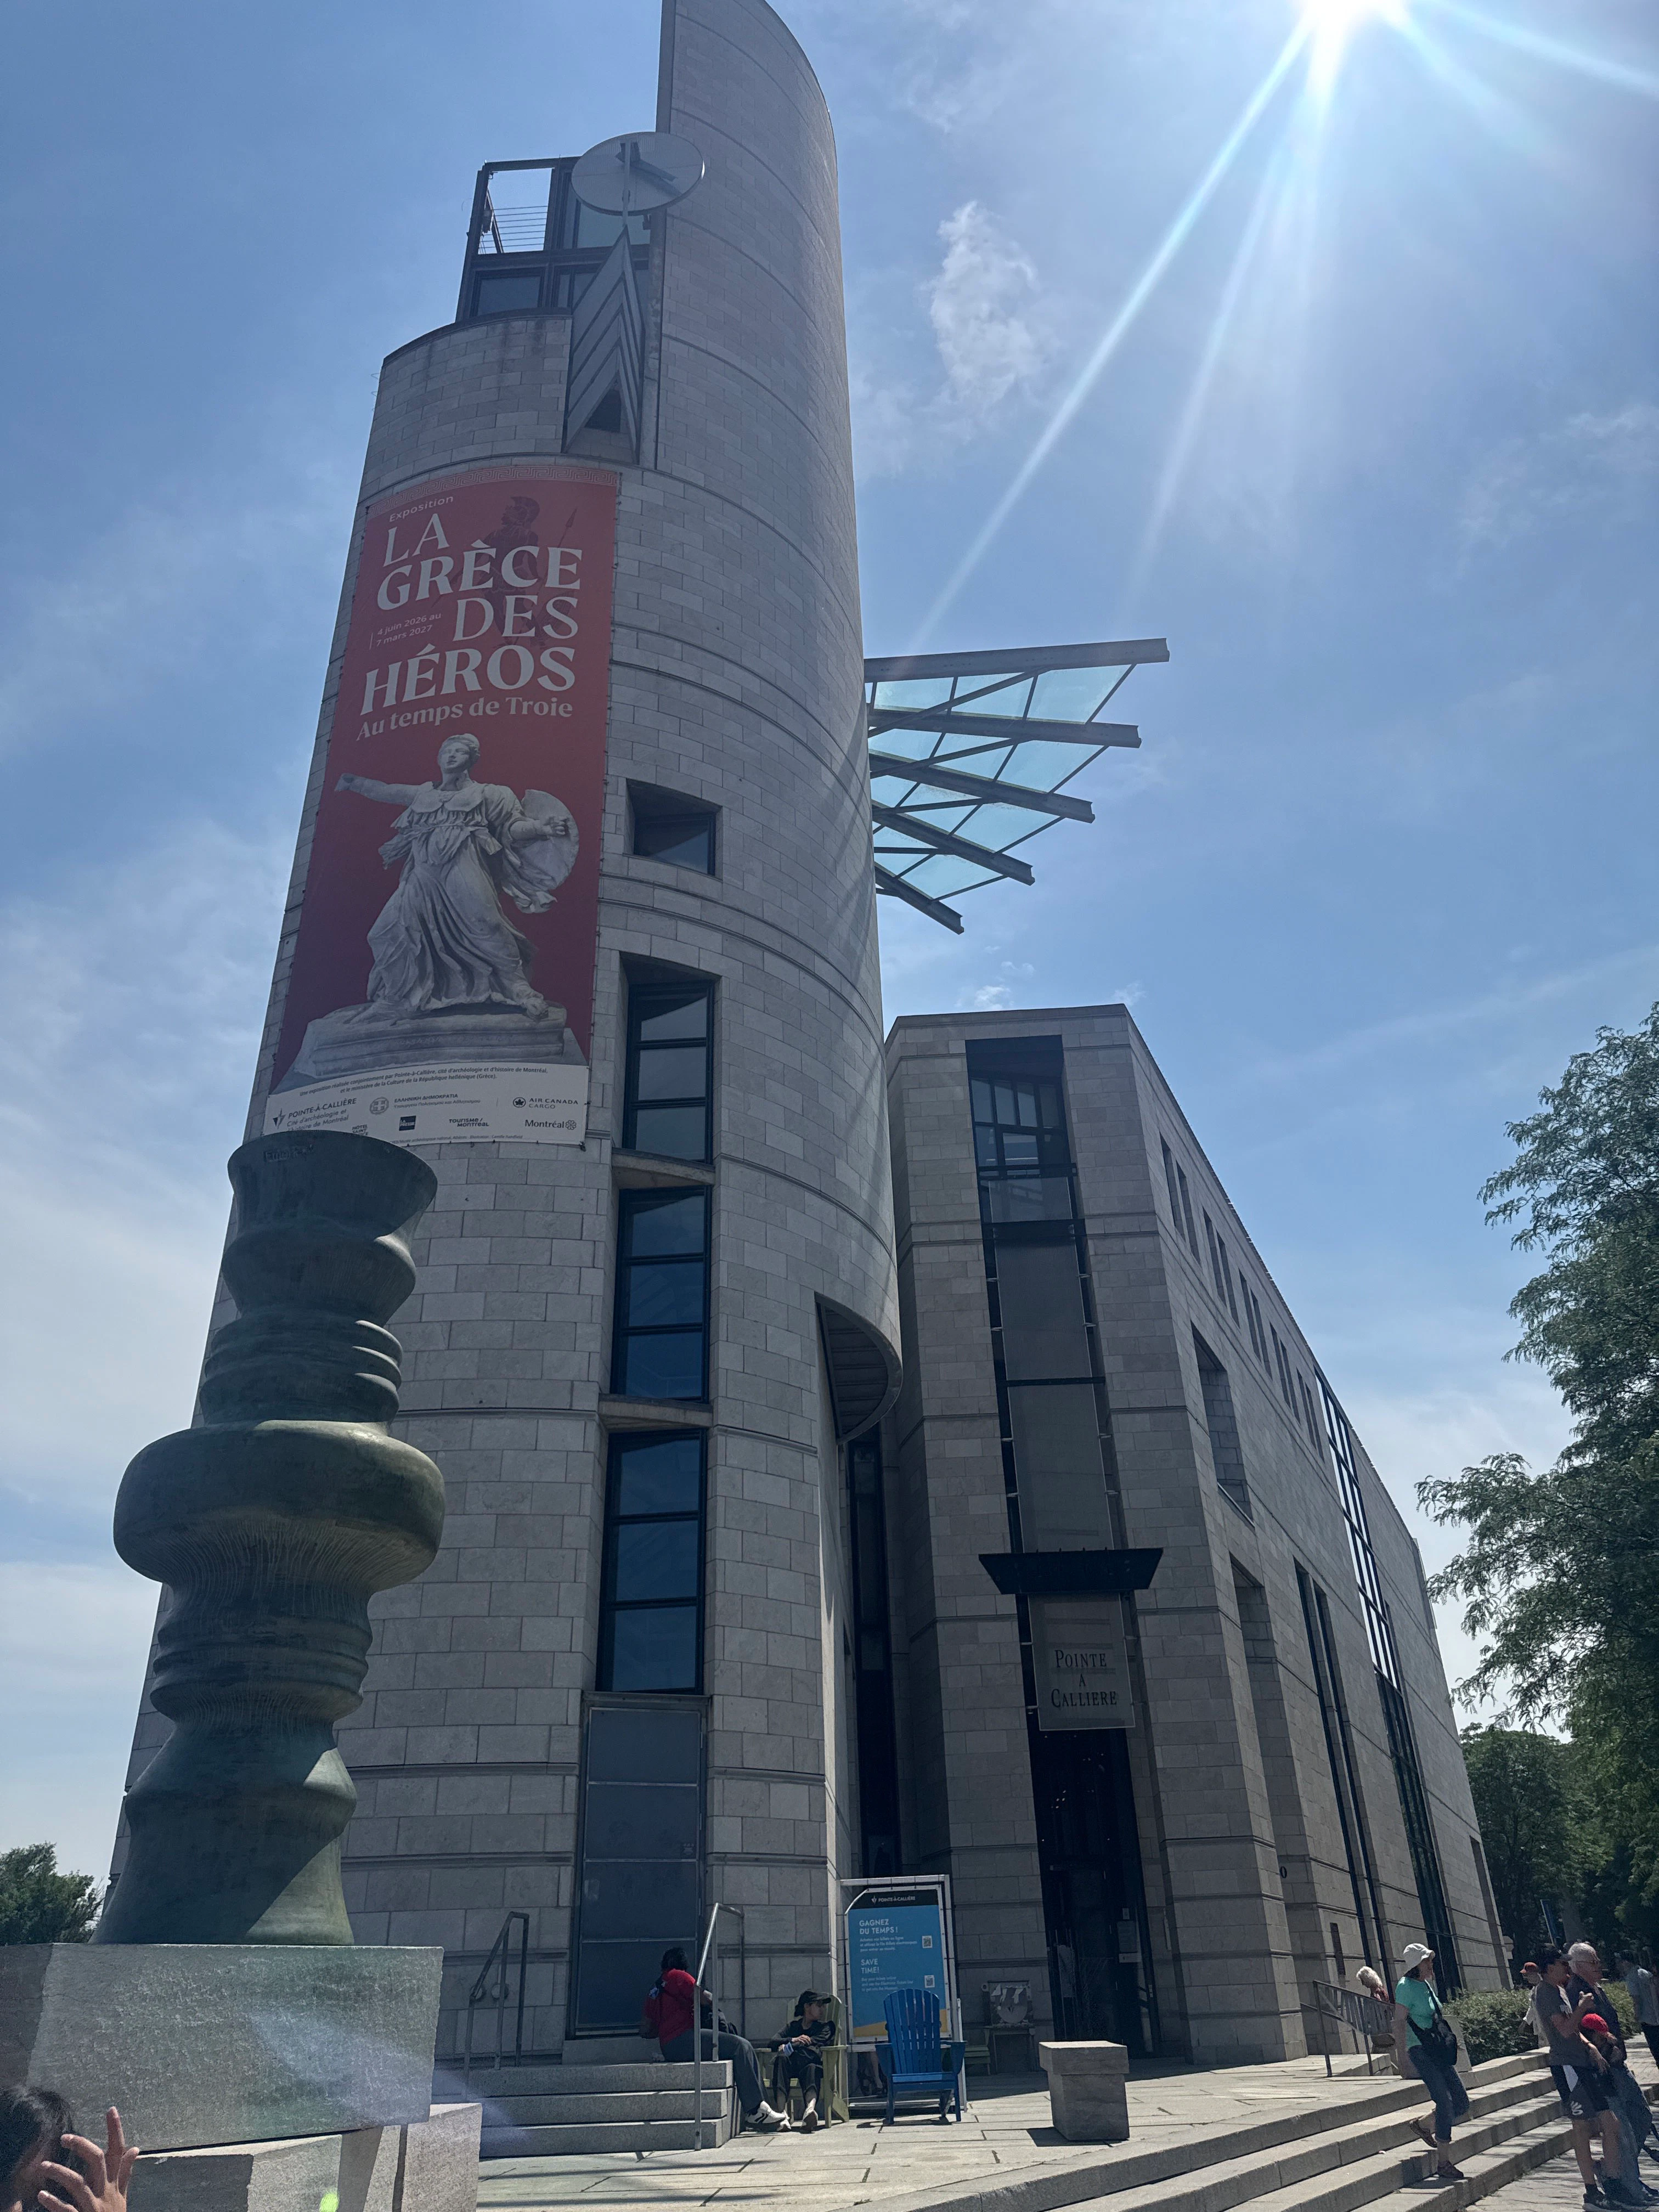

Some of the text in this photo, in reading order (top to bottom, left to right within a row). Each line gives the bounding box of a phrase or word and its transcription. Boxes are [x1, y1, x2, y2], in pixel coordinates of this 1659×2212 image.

[388, 495, 454, 523] Exposition
[383, 513, 450, 567] LA
[377, 539, 583, 611] GRÈCE
[383, 623, 402, 636] juin
[404, 615, 427, 627] 2026
[453, 595, 578, 642] DES
[383, 632, 407, 644] mars
[409, 624, 433, 636] 2027
[360, 643, 575, 716] HÉROS
[356, 696, 573, 741] Au temps de Troie
[524, 1120, 565, 1128] Montréal
[1054, 1649, 1107, 1668] POINTE
[1051, 1689, 1117, 1708] CALLIERE
